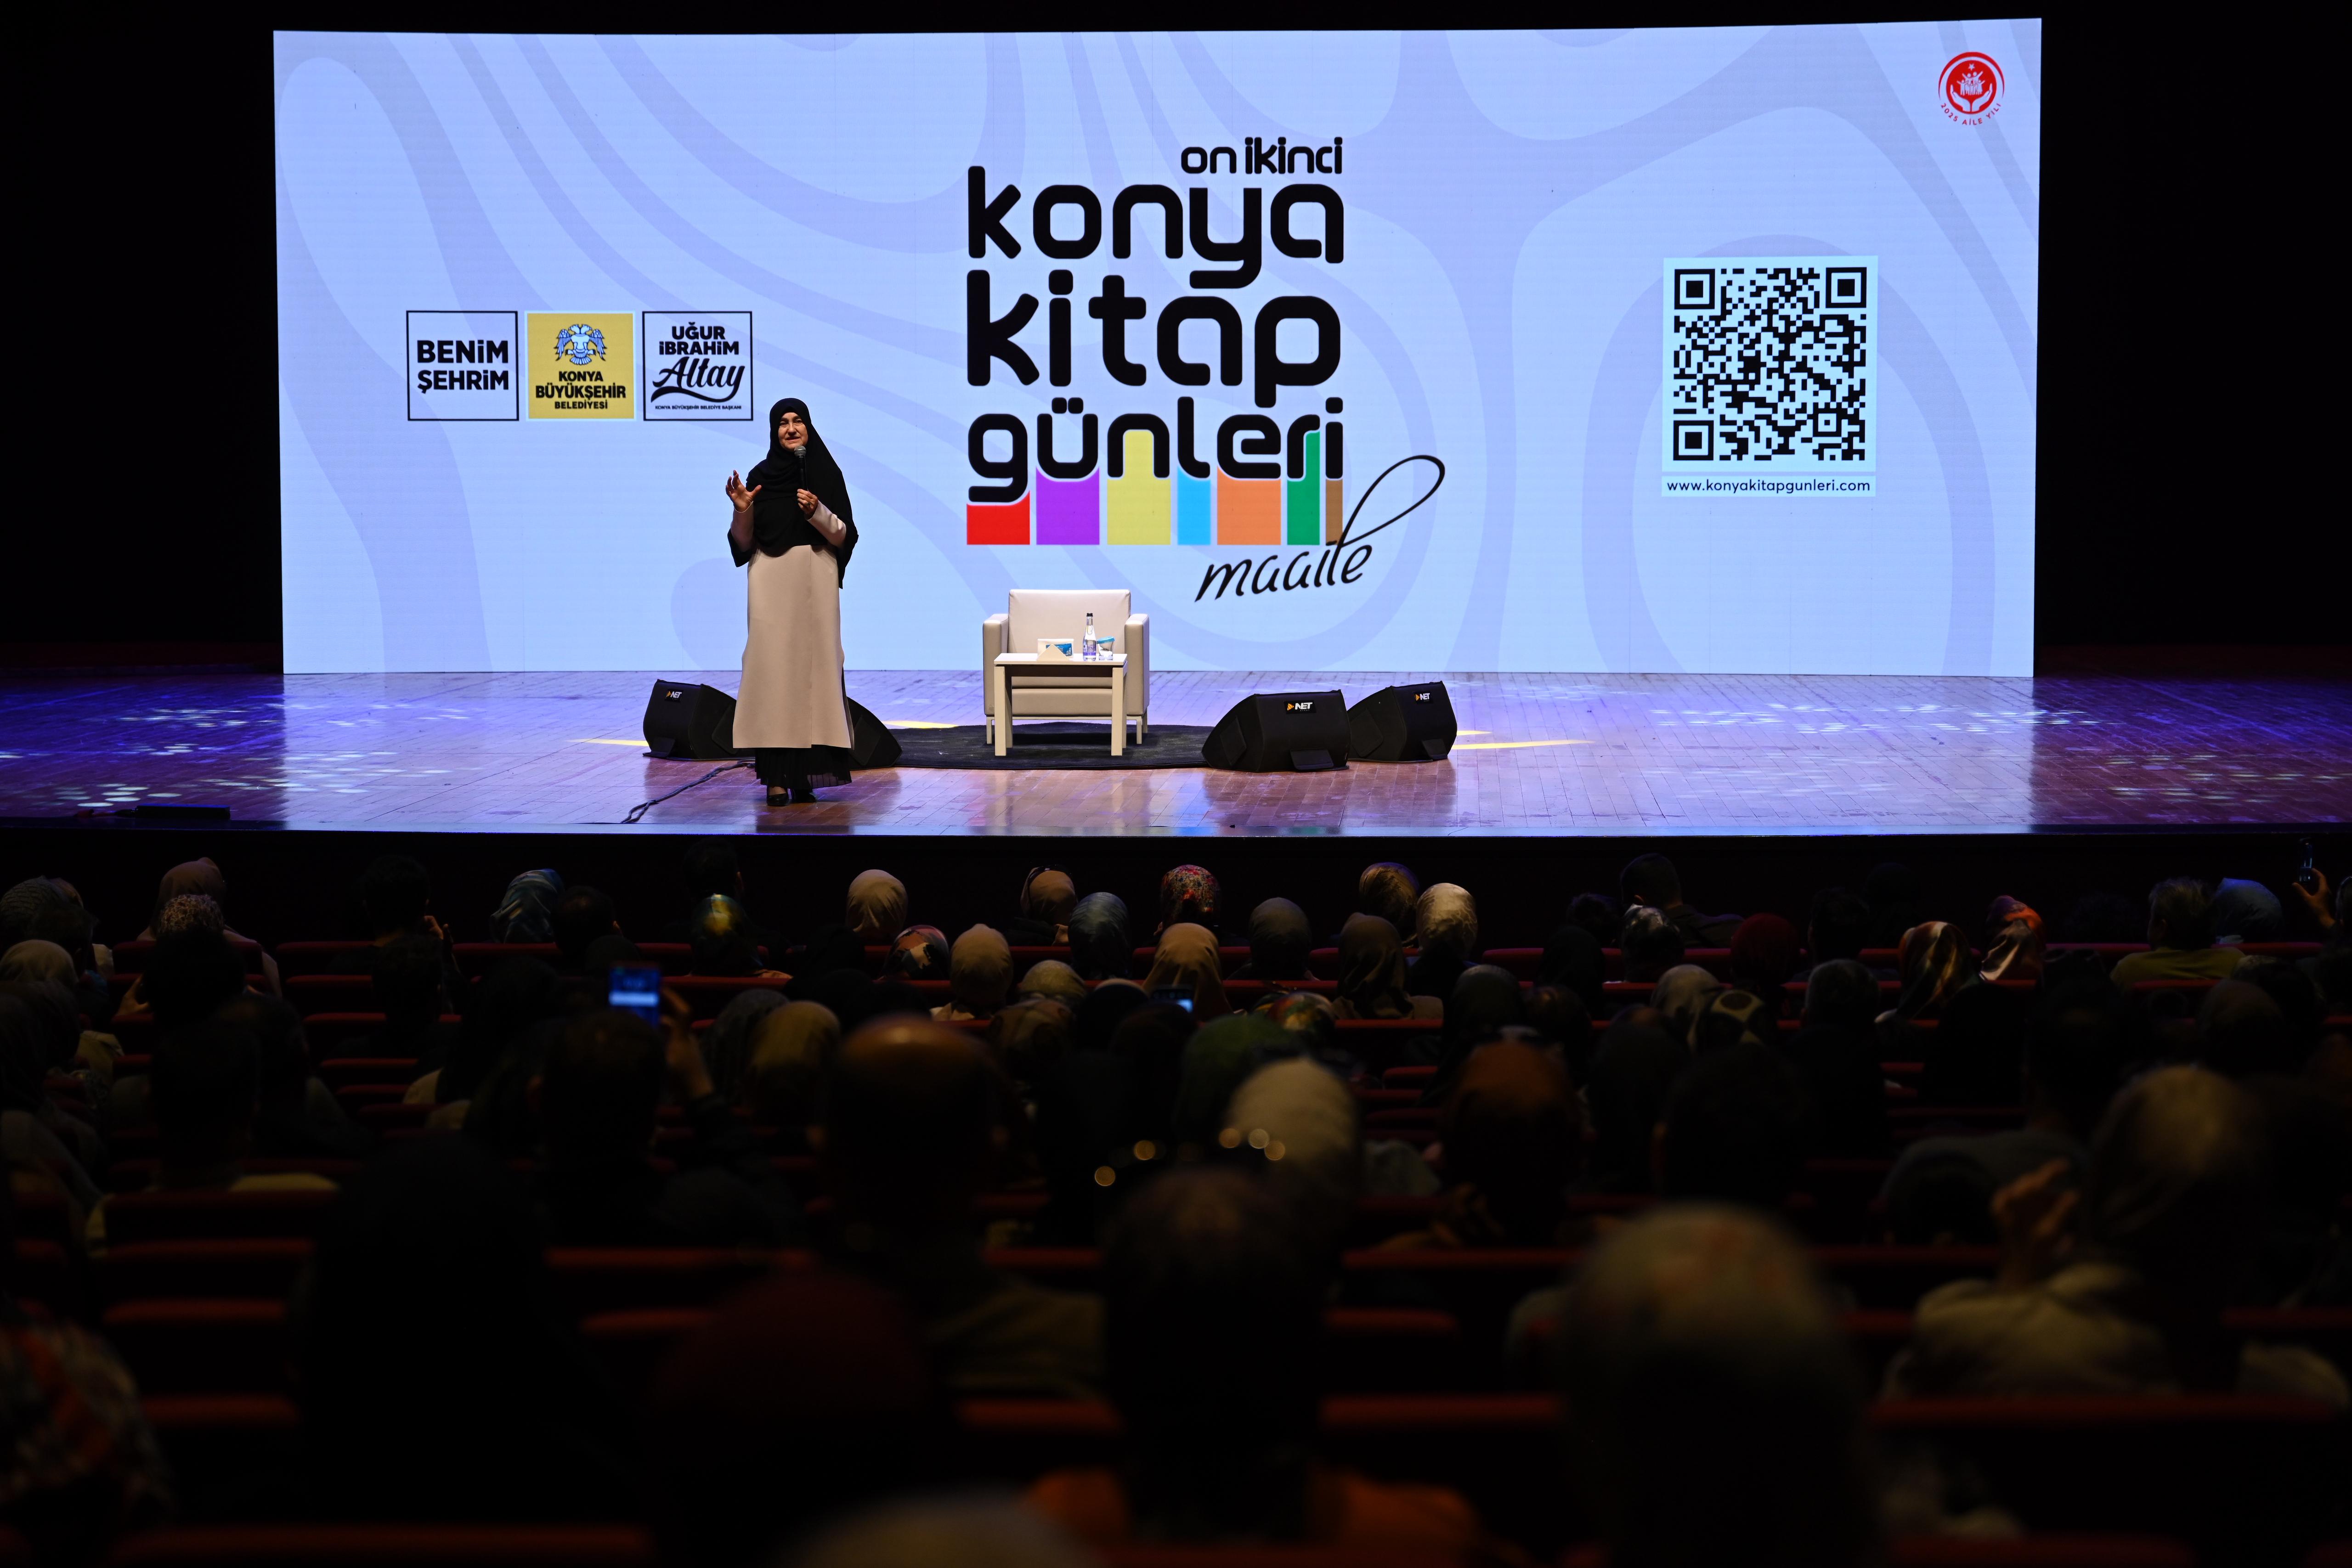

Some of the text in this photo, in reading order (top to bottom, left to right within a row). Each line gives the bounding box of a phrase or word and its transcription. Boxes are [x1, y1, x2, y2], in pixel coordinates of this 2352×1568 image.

[1941, 103, 1958, 122] 2025
[1181, 136, 1343, 174] on ikinci
[967, 166, 1344, 289] konya
[672, 321, 726, 340] UĞUR
[967, 270, 1341, 408] kitap
[559, 371, 604, 382] KONYA
[651, 356, 745, 403] Altay
[535, 383, 626, 400] BÜYÜKŞEHİR
[554, 399, 608, 409] BELEDİYESİ
[967, 396, 1343, 503] günleri
[1667, 479, 1871, 494] www.konyakitapgunleri.com
[1194, 455, 1445, 603] maaile
[1295, 702, 1313, 710] NET
